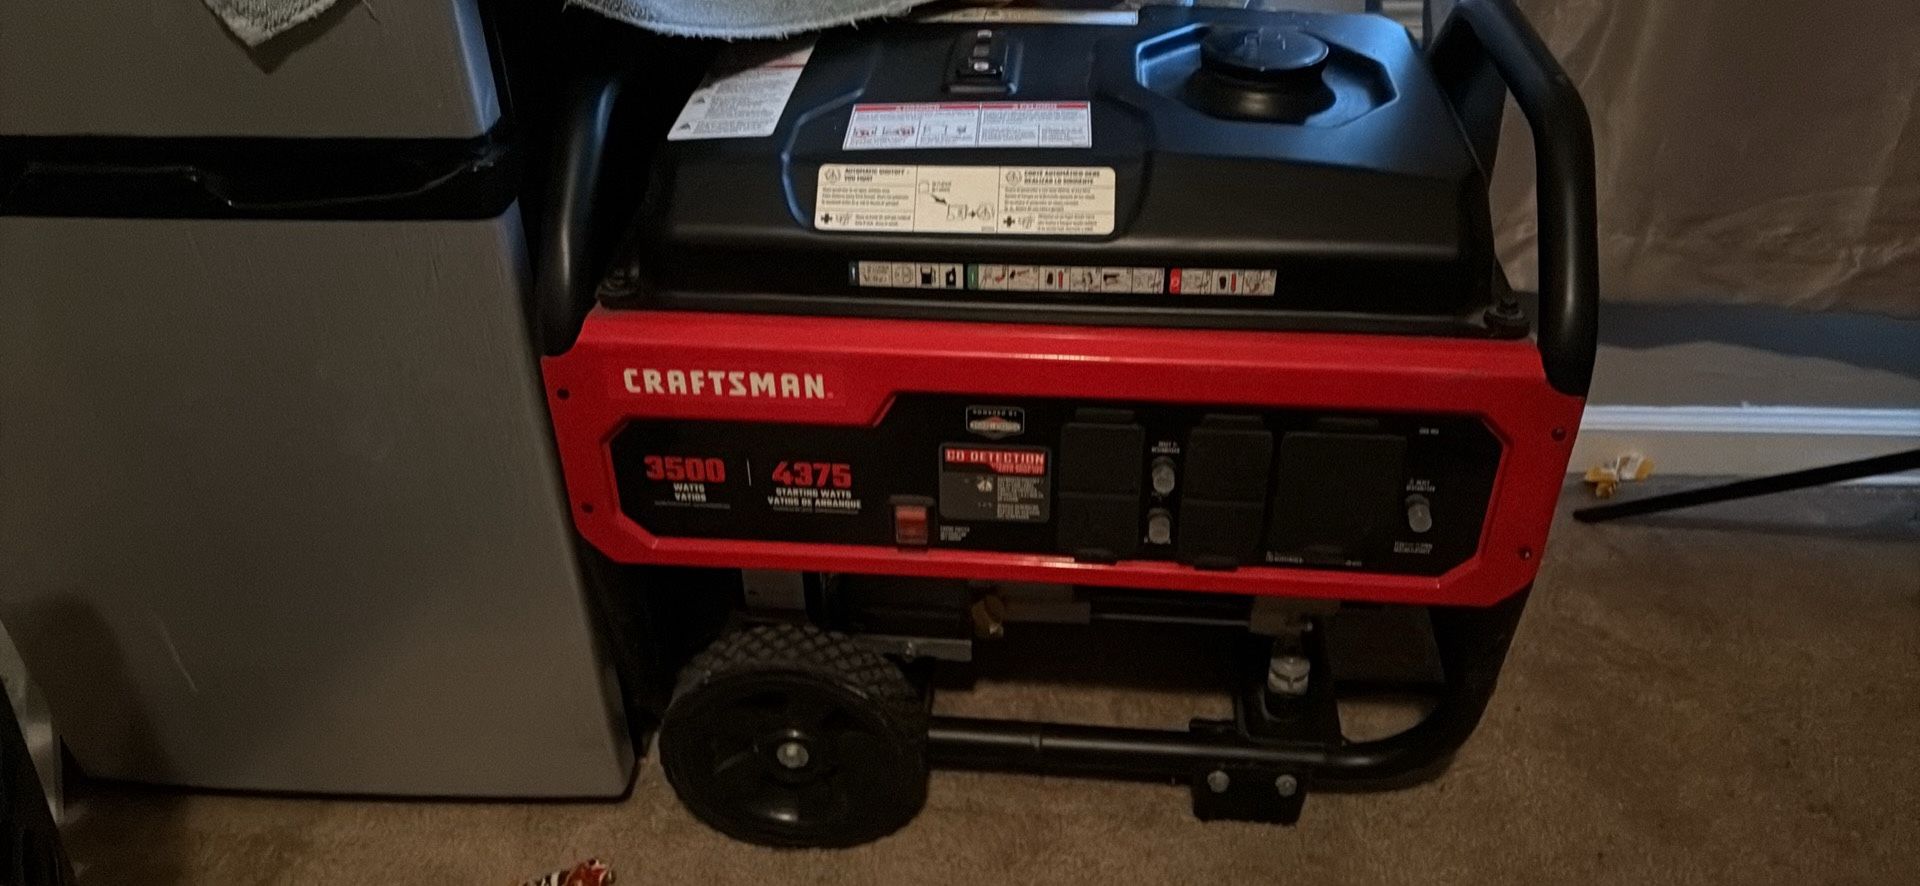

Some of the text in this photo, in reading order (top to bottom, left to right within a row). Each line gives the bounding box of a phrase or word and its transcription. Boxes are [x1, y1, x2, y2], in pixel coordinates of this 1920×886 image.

[623, 367, 826, 399] CRAFTSMAN
[970, 449, 1045, 465] DETECTION
[643, 454, 726, 483] 3500
[771, 460, 852, 489] 4375
[673, 482, 705, 493] WATTS
[775, 487, 852, 500] STARTING WATTS
[674, 492, 707, 502] VATIOS
[767, 496, 800, 507] VATIOS
[801, 498, 813, 508] DE
